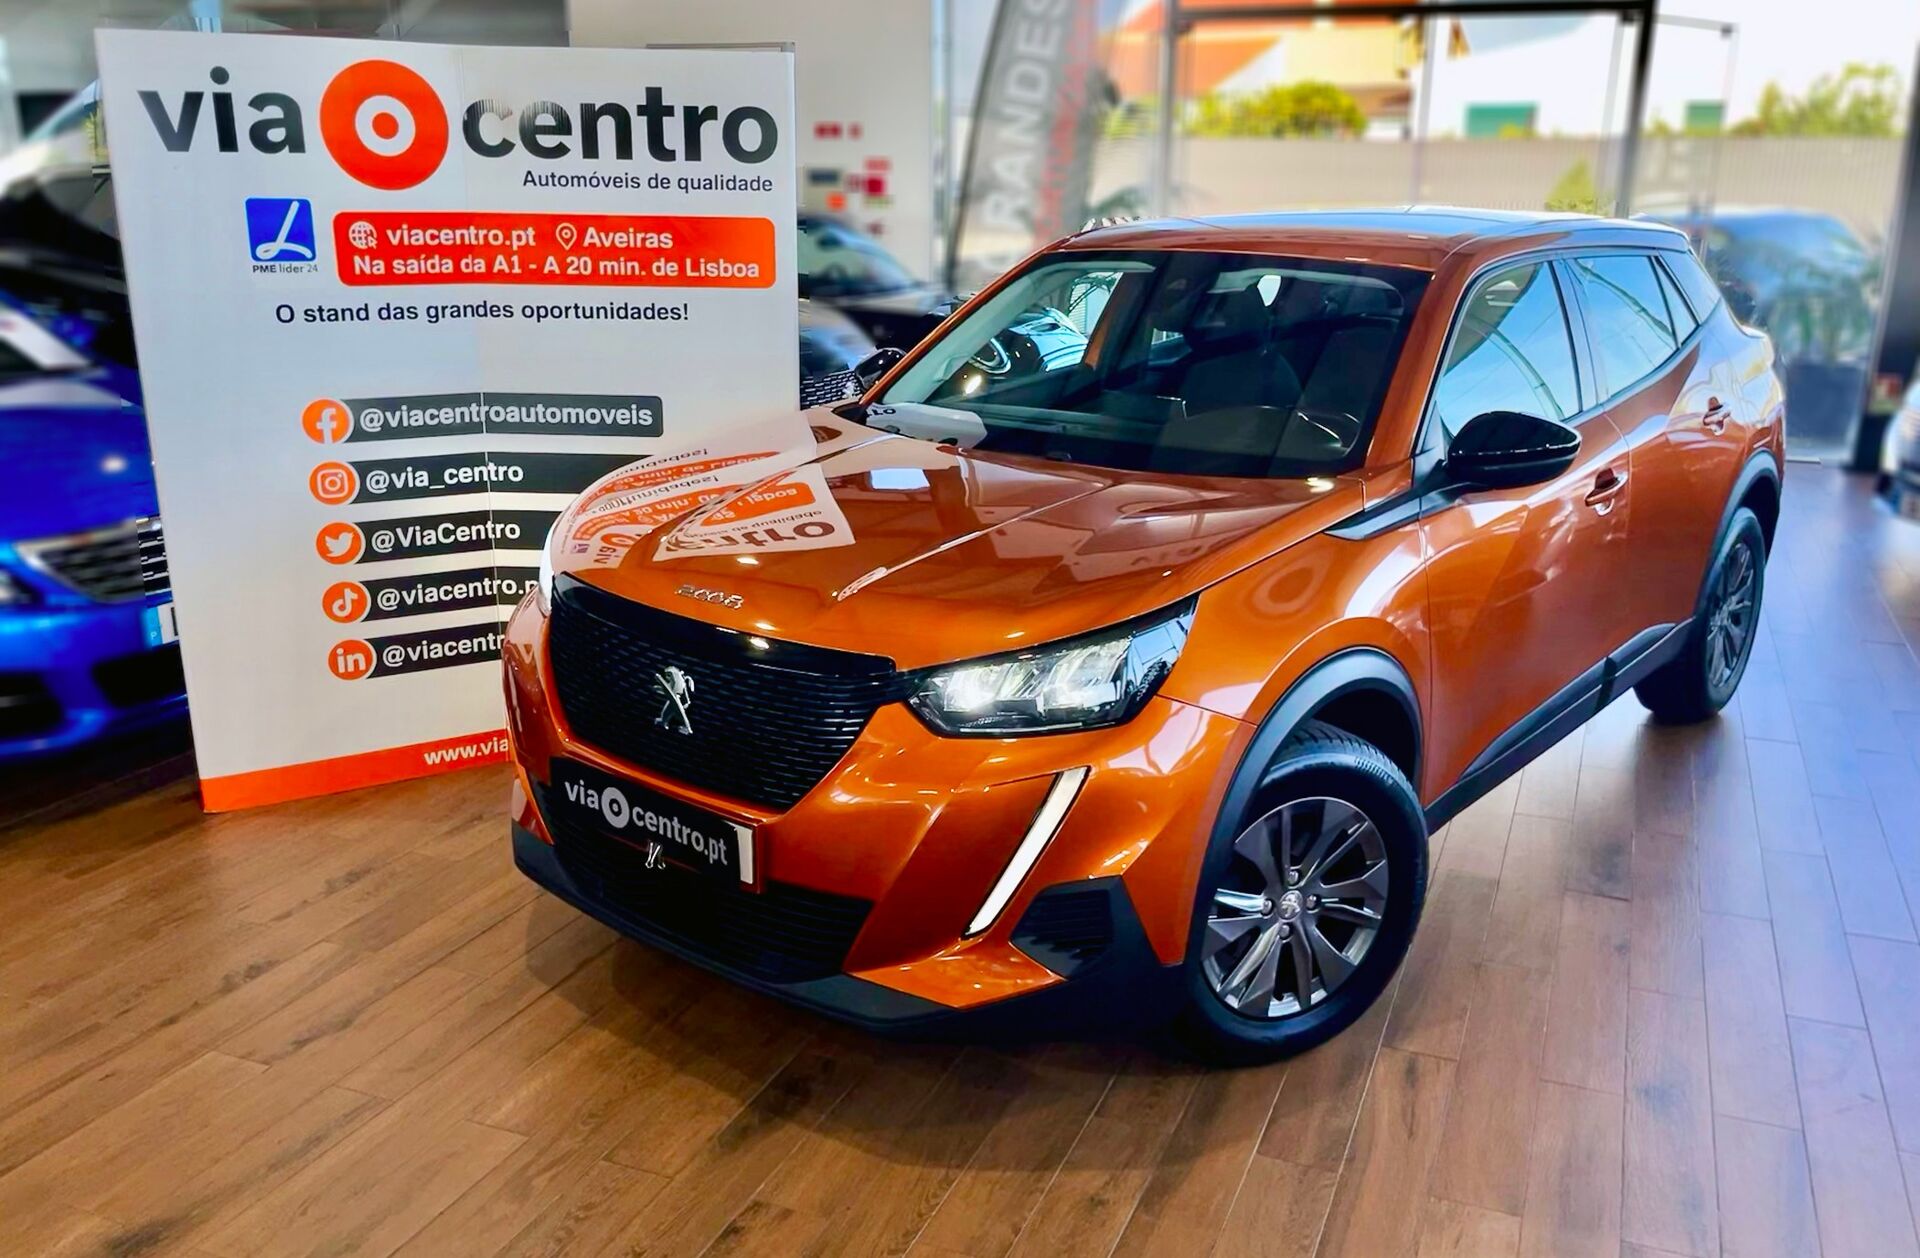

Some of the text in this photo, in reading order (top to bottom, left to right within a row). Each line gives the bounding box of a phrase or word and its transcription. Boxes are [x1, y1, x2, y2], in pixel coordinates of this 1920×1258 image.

[137, 66, 778, 164] via centro
[523, 170, 773, 194] Automóveis de qualidade
[386, 224, 536, 250] viacentro.pt
[583, 227, 673, 249] Aveiras
[252, 264, 277, 273] PME
[353, 255, 385, 275] Na
[392, 254, 454, 275] saída
[460, 255, 486, 273] da
[493, 254, 522, 274] A1
[543, 256, 561, 274] A
[566, 256, 592, 275] 20
[599, 257, 646, 276] min.
[652, 258, 679, 276] de
[685, 258, 760, 278] Lisboa
[275, 301, 689, 324] O stand das grandes oportunidades!
[360, 403, 653, 433] @viacentroautomoveis
[366, 461, 524, 494] @via_centro
[371, 519, 521, 554] @ViaCentro
[377, 577, 539, 612] @viacentro.p
[382, 632, 505, 668] @viacentr
[423, 737, 508, 765] www.via
[565, 779, 728, 867] via centro.pt
